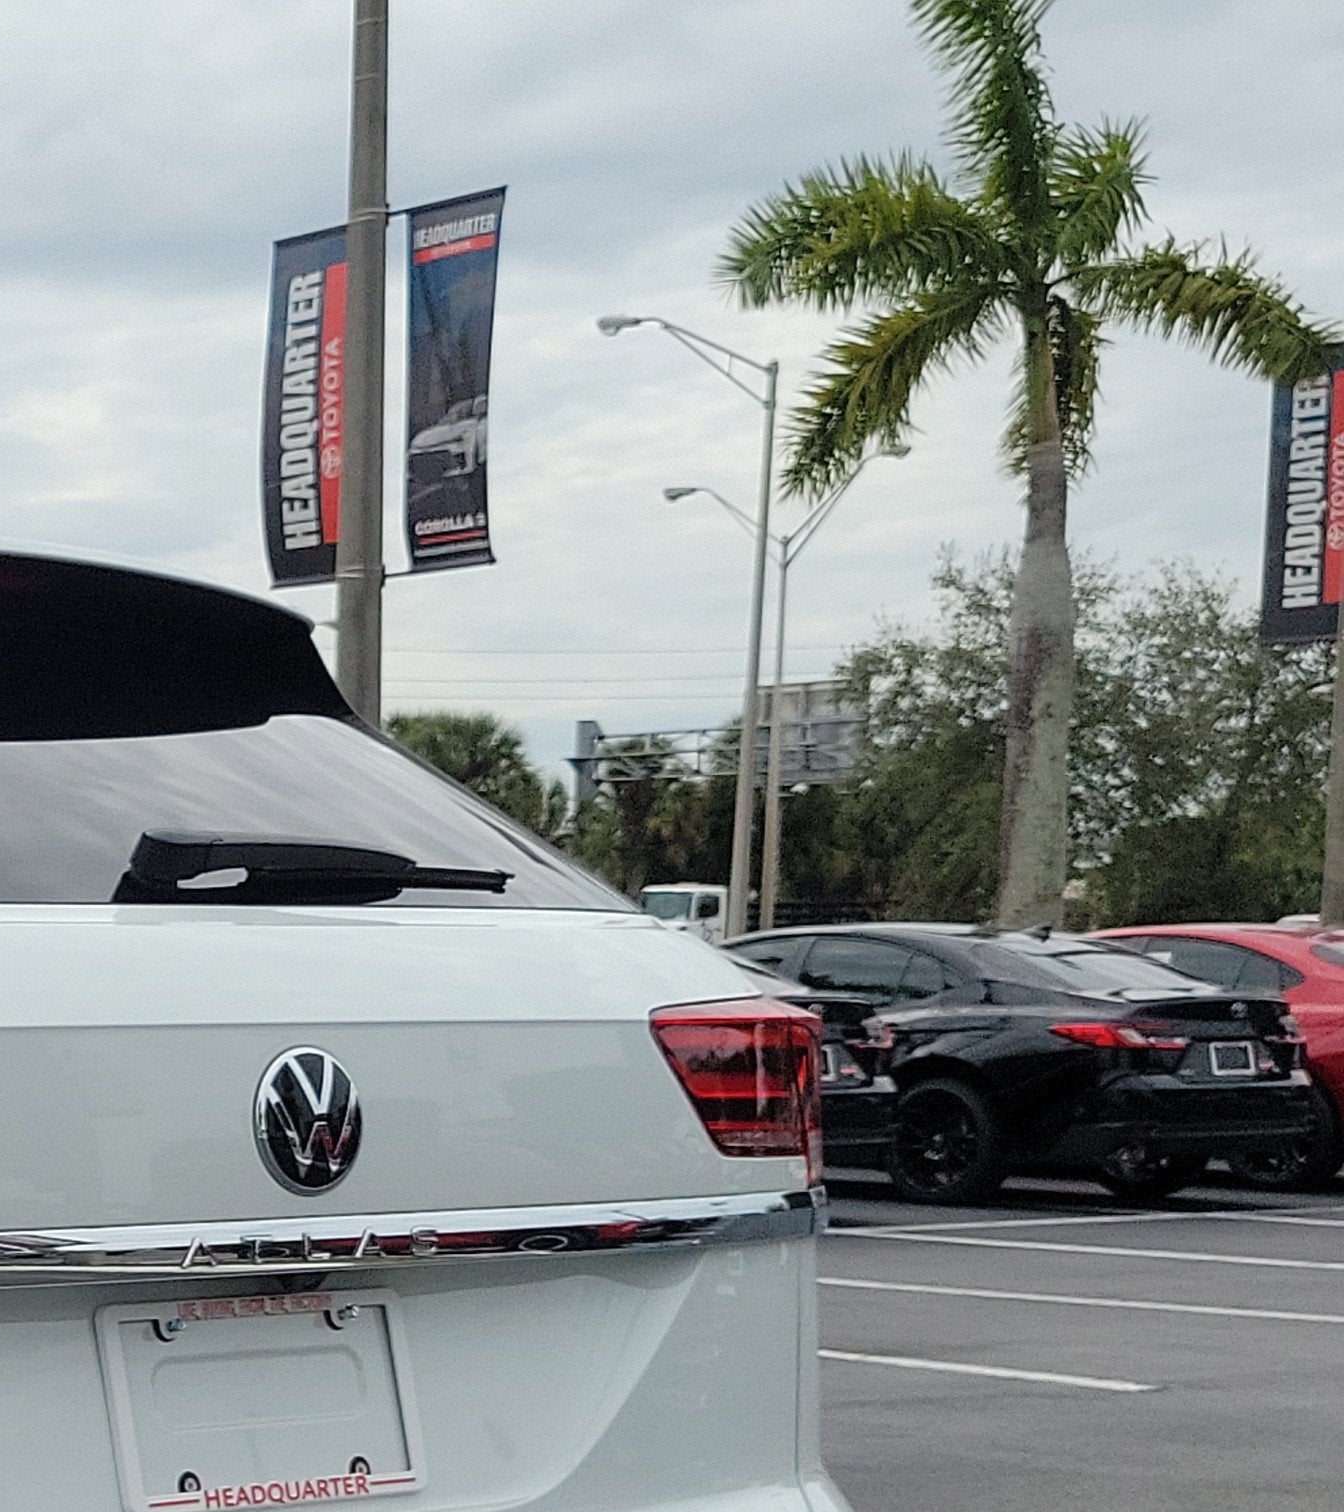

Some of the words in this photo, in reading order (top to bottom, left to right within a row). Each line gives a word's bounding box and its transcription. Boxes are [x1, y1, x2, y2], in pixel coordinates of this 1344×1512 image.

[280, 270, 323, 550] HEADQUARTER
[322, 337, 342, 442] TOYOTA
[1282, 374, 1330, 609] HEADQUARTER
[181, 1224, 439, 1268] ATLAS
[203, 1475, 369, 1509] HEADQUARTER
